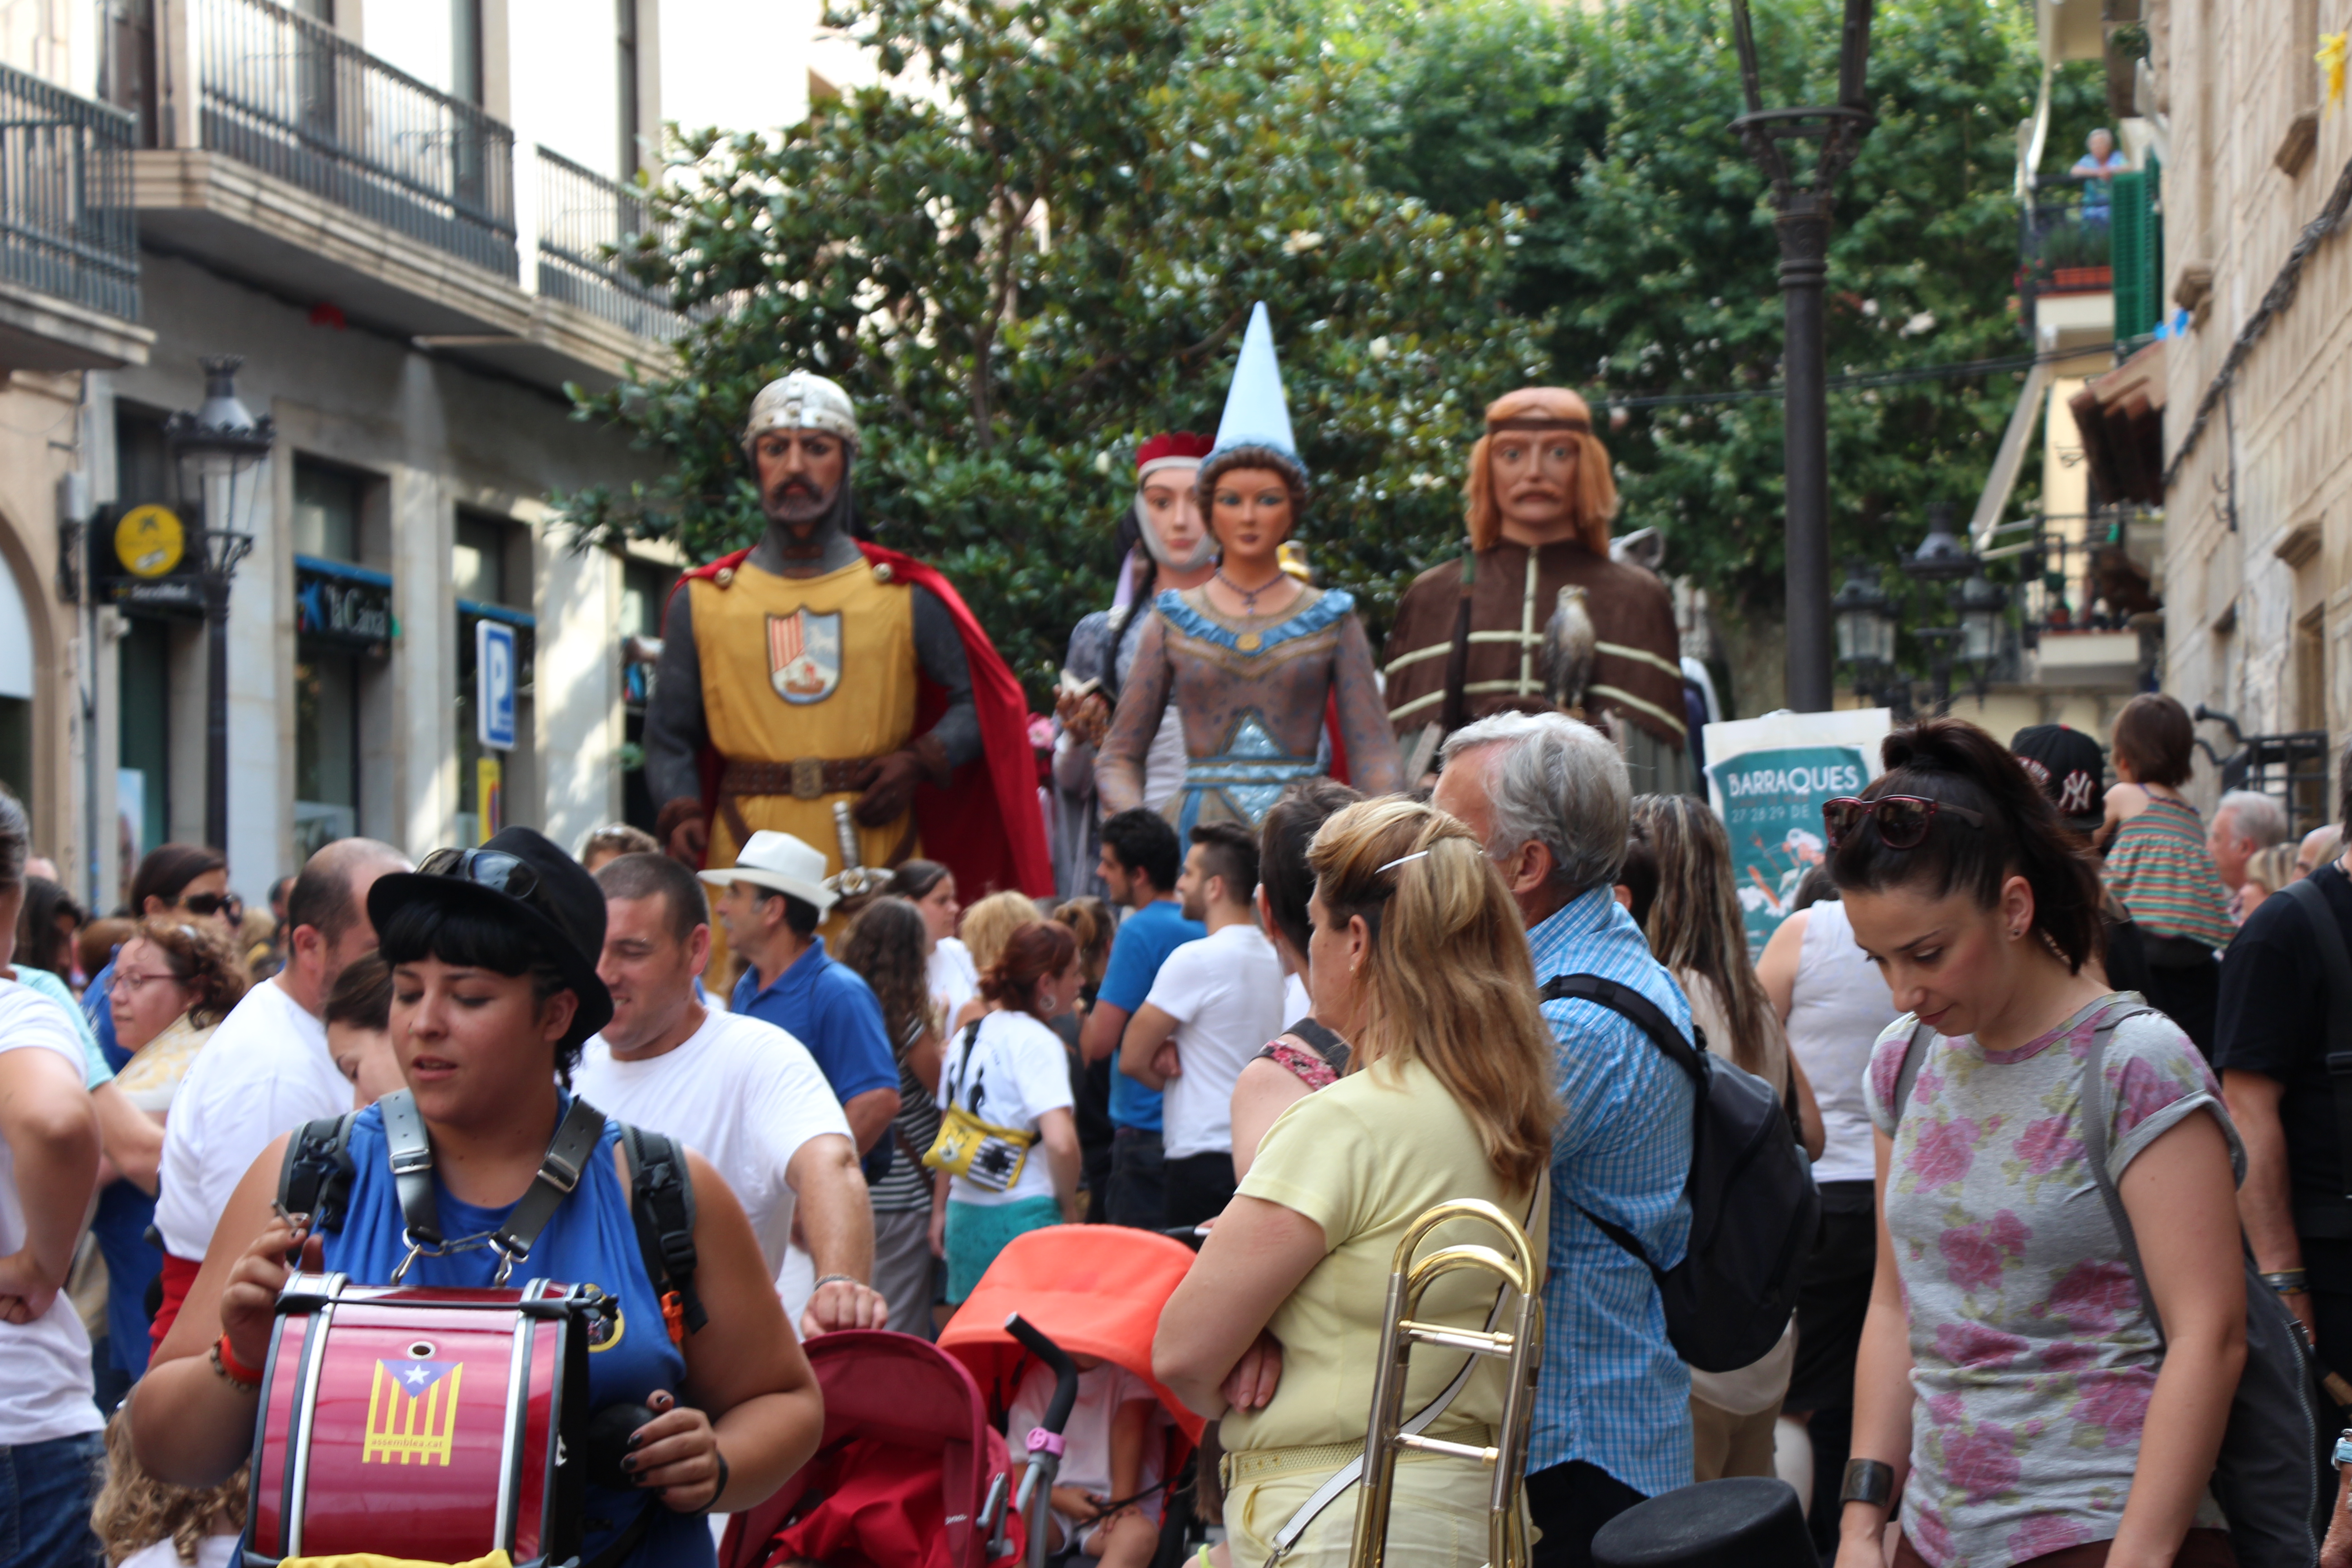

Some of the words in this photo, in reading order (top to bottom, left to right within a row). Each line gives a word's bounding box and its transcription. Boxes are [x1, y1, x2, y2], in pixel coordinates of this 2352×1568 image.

[489, 639, 508, 729] P
[1727, 765, 1860, 797] BARRAQUES
[1732, 808, 1746, 823] 27
[1750, 806, 1766, 822] 28
[1769, 805, 1785, 820] 29
[1791, 804, 1810, 818] DE
[372, 1438, 443, 1447] assemblea.cat
